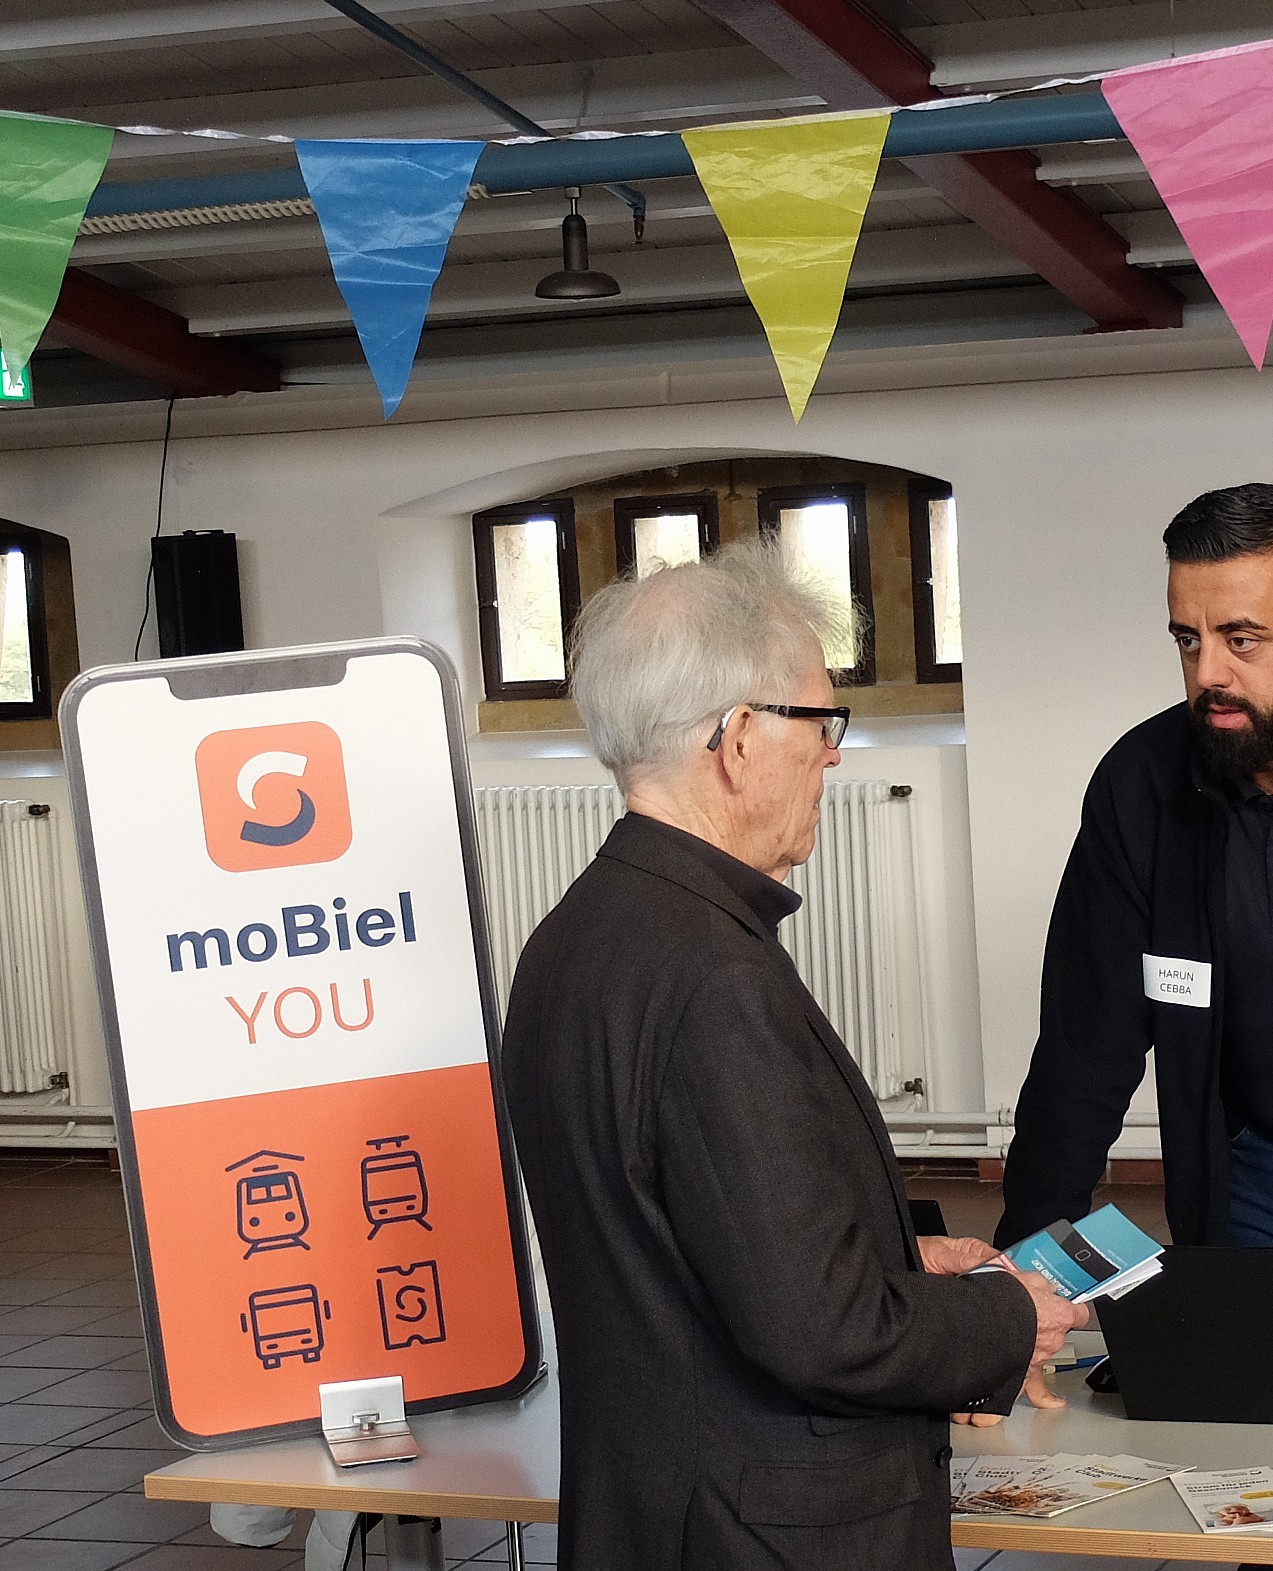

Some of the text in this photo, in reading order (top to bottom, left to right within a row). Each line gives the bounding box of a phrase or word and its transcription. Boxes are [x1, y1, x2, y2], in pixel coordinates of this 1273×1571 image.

[166, 891, 417, 973] moBiel
[1158, 968, 1194, 982] HARUN
[1160, 982, 1192, 996] CEBBA
[225, 978, 375, 1045] YOU
